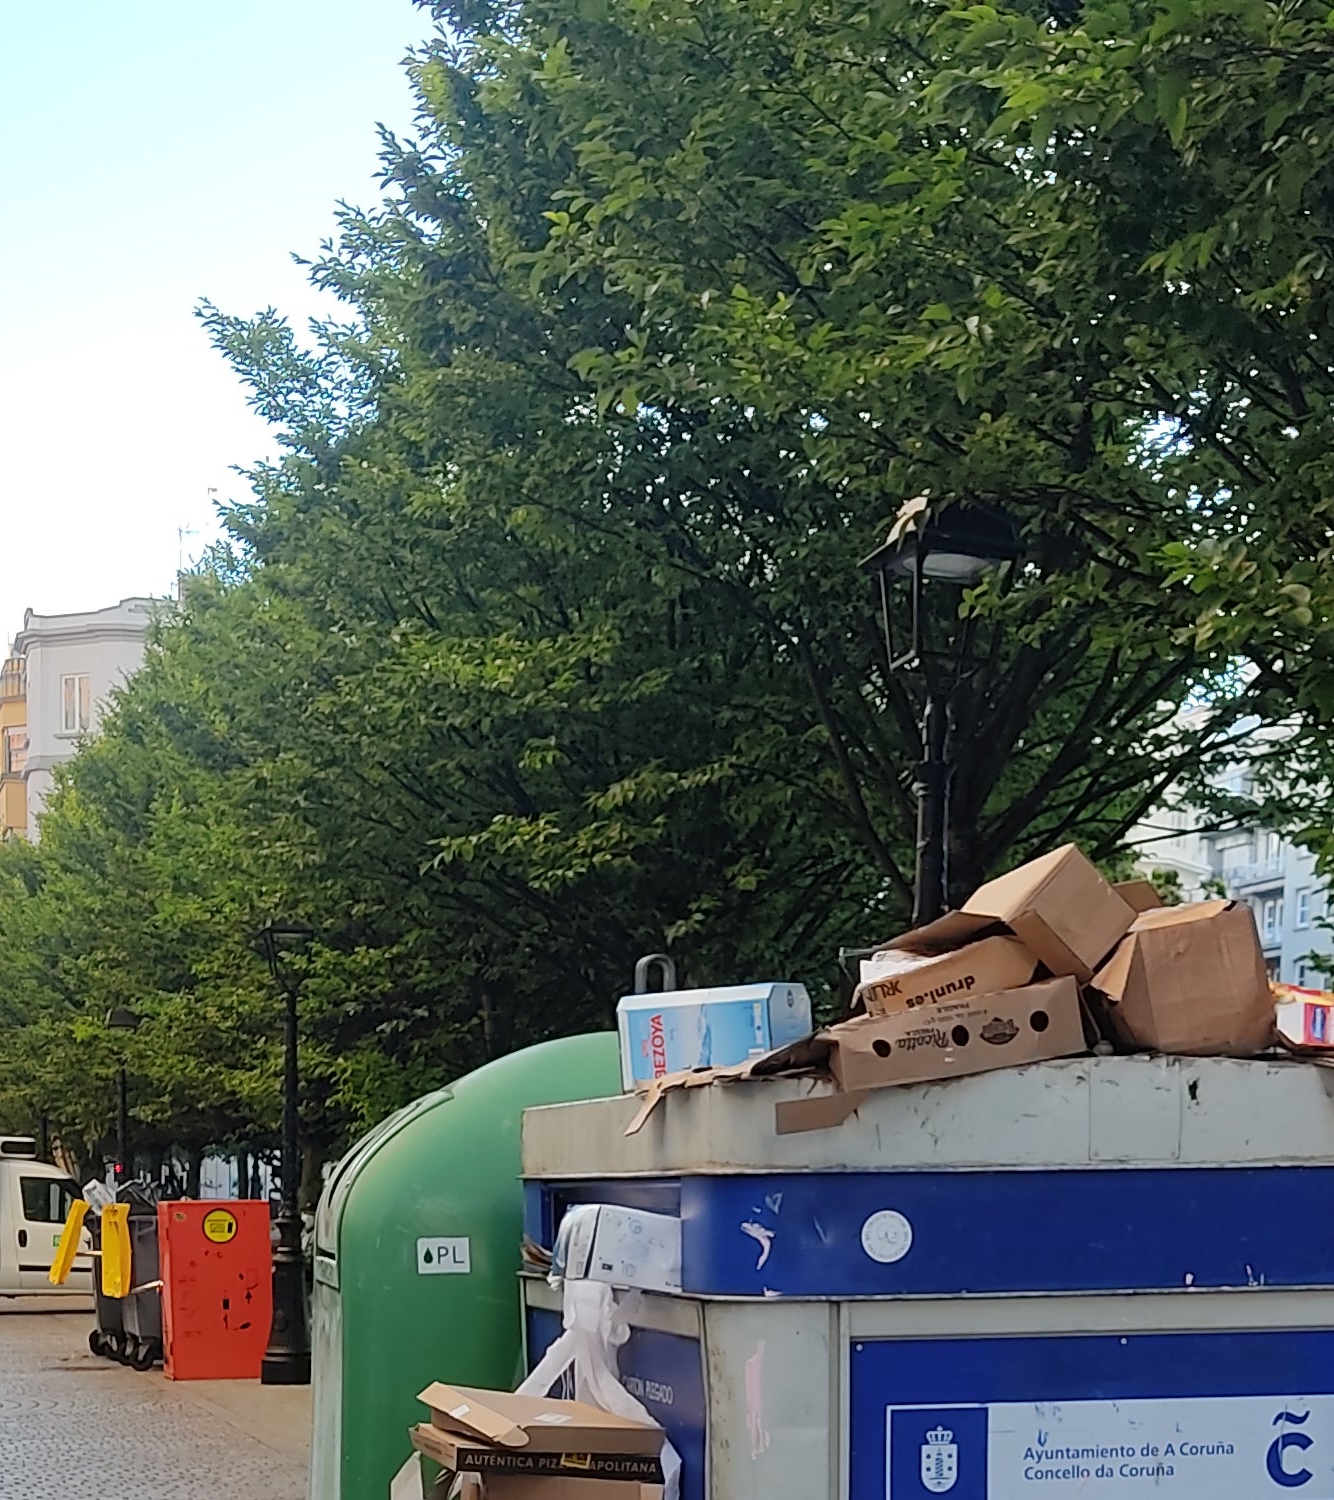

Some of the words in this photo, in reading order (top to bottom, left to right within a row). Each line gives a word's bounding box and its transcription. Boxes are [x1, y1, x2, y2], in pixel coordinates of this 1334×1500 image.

[650, 1014, 667, 1080] BEZOYA
[895, 1028, 951, 1051] Ricotta
[1022, 1444, 1136, 1465] Ayuntamiento
[1139, 1442, 1160, 1458] de
[1163, 1442, 1176, 1457] A
[1178, 1440, 1235, 1457] Coruña
[587, 1457, 657, 1474] APOLITANA
[1023, 1464, 1090, 1481] Concello
[1094, 1463, 1114, 1479] da
[1118, 1461, 1175, 1478] Coruña
